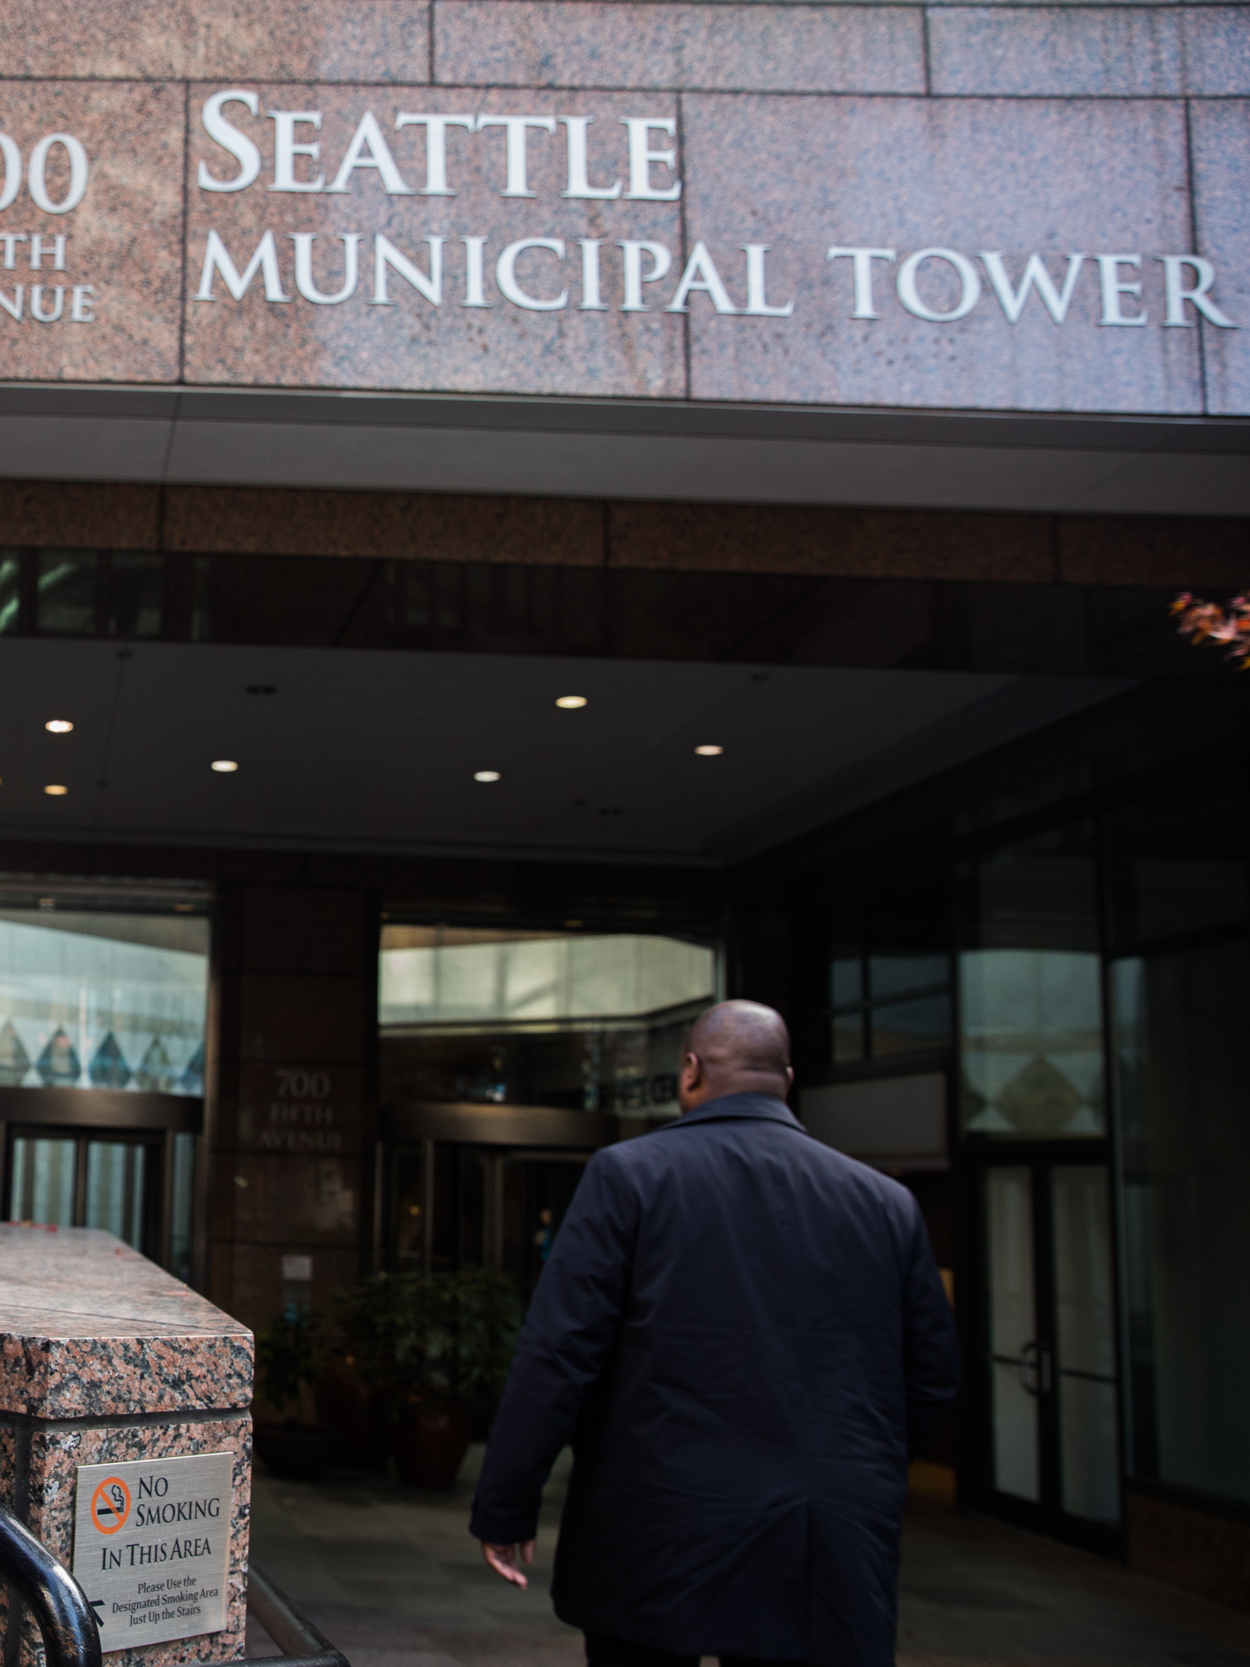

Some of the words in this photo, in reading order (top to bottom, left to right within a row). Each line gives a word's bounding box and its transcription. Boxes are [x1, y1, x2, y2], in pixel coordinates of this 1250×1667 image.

[198, 90, 682, 201] SEATTLE
[193, 230, 794, 317] MUNICIPAL
[828, 247, 1239, 328] TOWER
[275, 1069, 331, 1099] 700
[135, 1498, 220, 1526] SMOKING
[126, 1543, 167, 1566] THIS
[170, 1538, 212, 1560] AREA
[137, 1581, 164, 1594] Please
[167, 1579, 182, 1588] Use
[184, 1576, 196, 1586] the
[112, 1596, 160, 1615] Designated
[162, 1590, 199, 1606] Smoking
[200, 1588, 218, 1598] Area
[129, 1614, 147, 1627] Just
[148, 1611, 160, 1624] Up
[162, 1610, 175, 1620] the
[177, 1605, 201, 1618] Stairs
